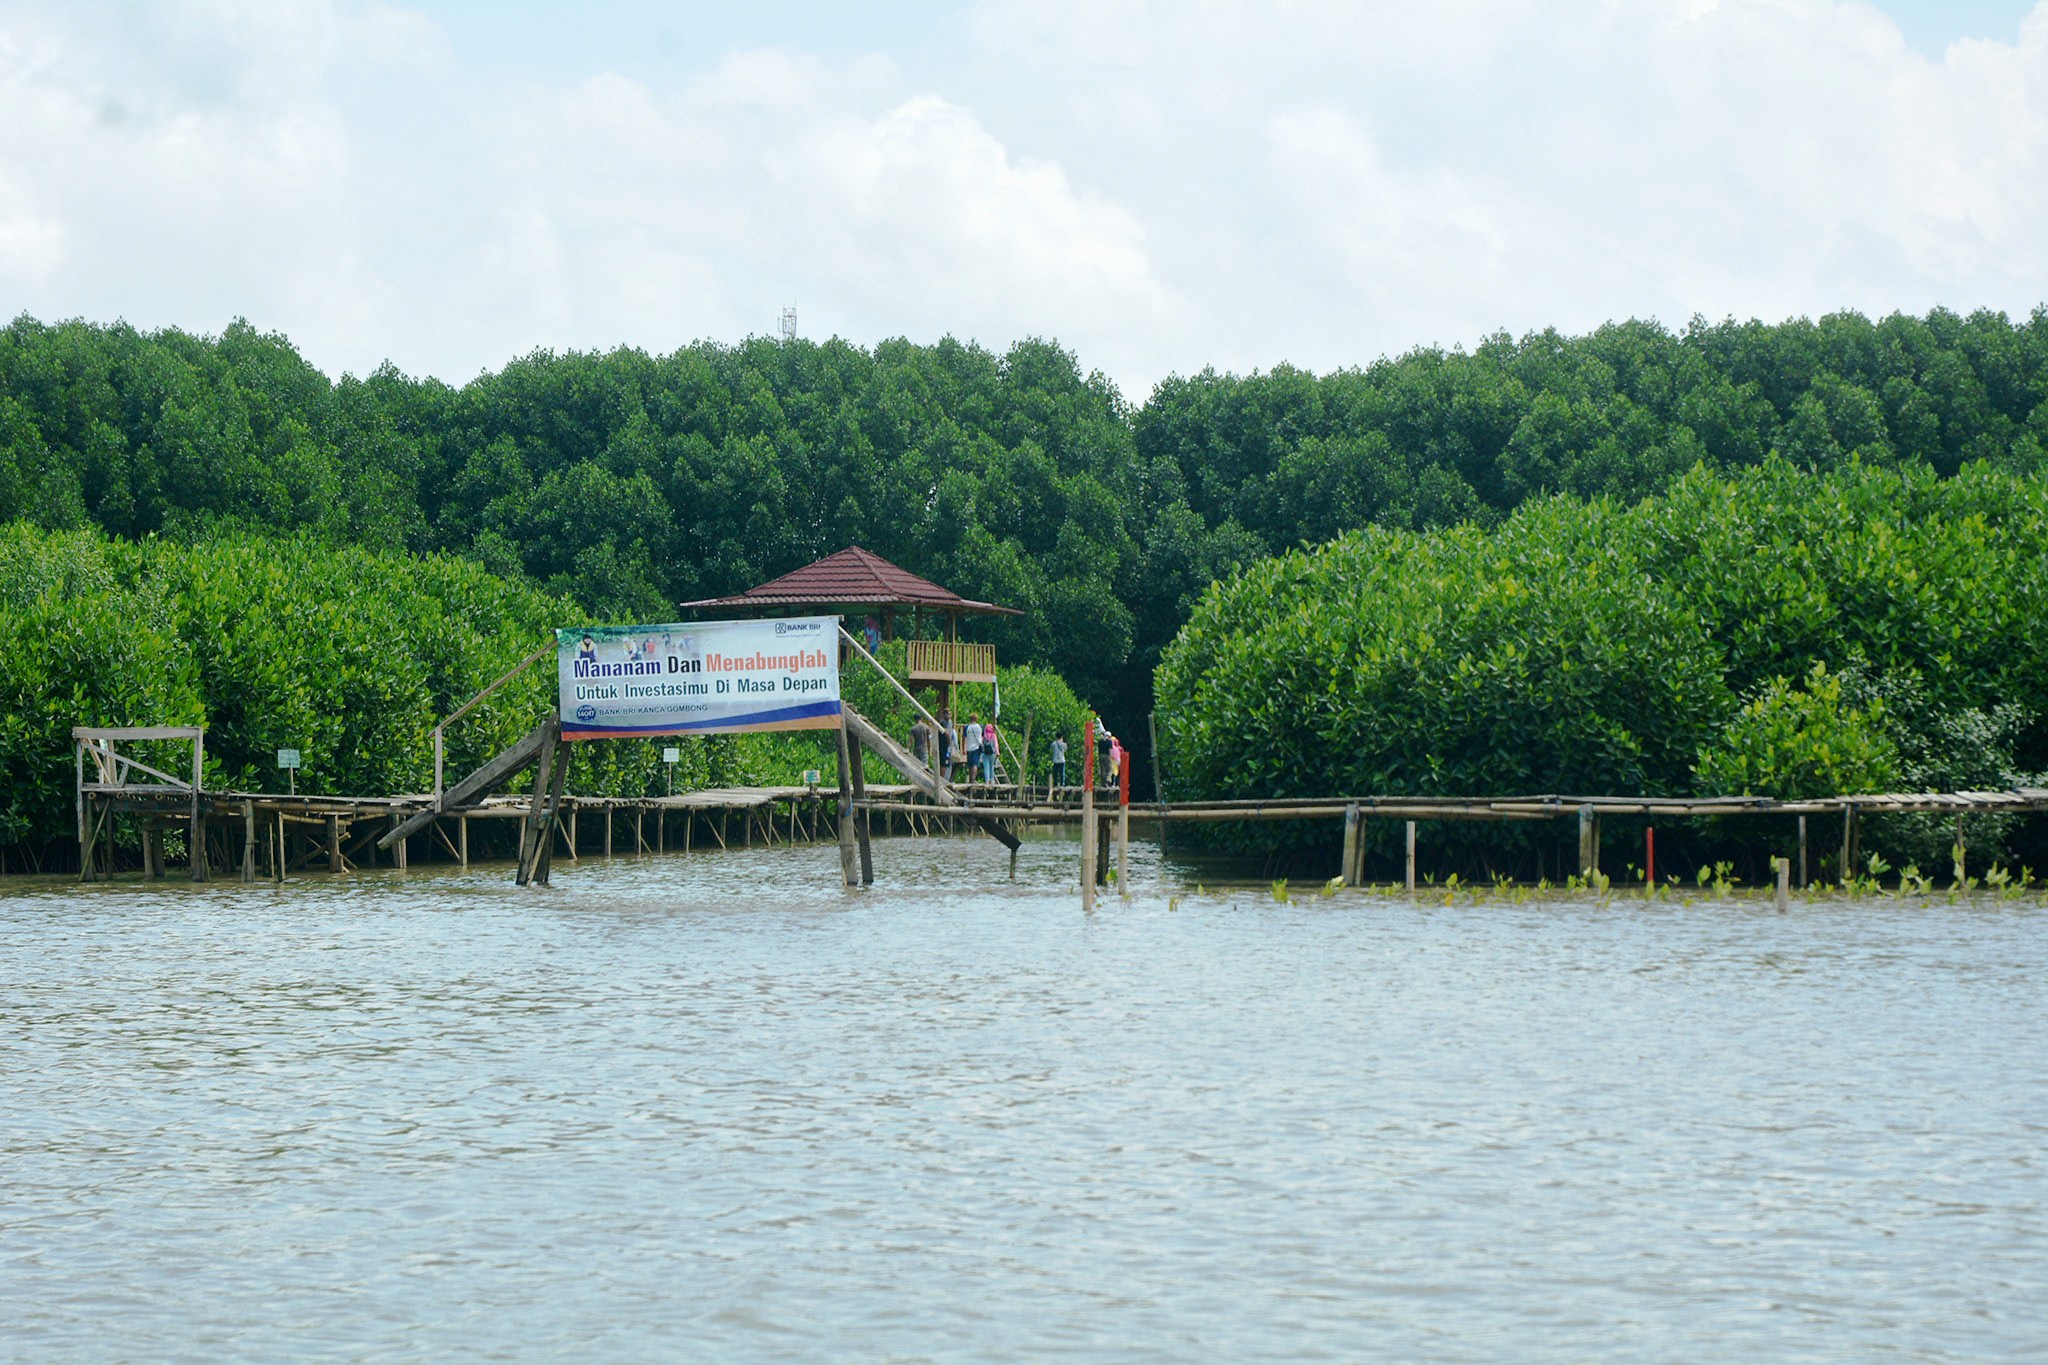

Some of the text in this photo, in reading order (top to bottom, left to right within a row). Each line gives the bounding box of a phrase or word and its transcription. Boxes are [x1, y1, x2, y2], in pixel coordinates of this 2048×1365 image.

[787, 623, 821, 631] BANK BRI
[574, 649, 827, 679] Mananam Dan Menabunglah
[576, 676, 828, 700] Untuk Investasimu Di Masa Depan
[599, 704, 709, 716] BANK BRI KANCA GOMBONG
